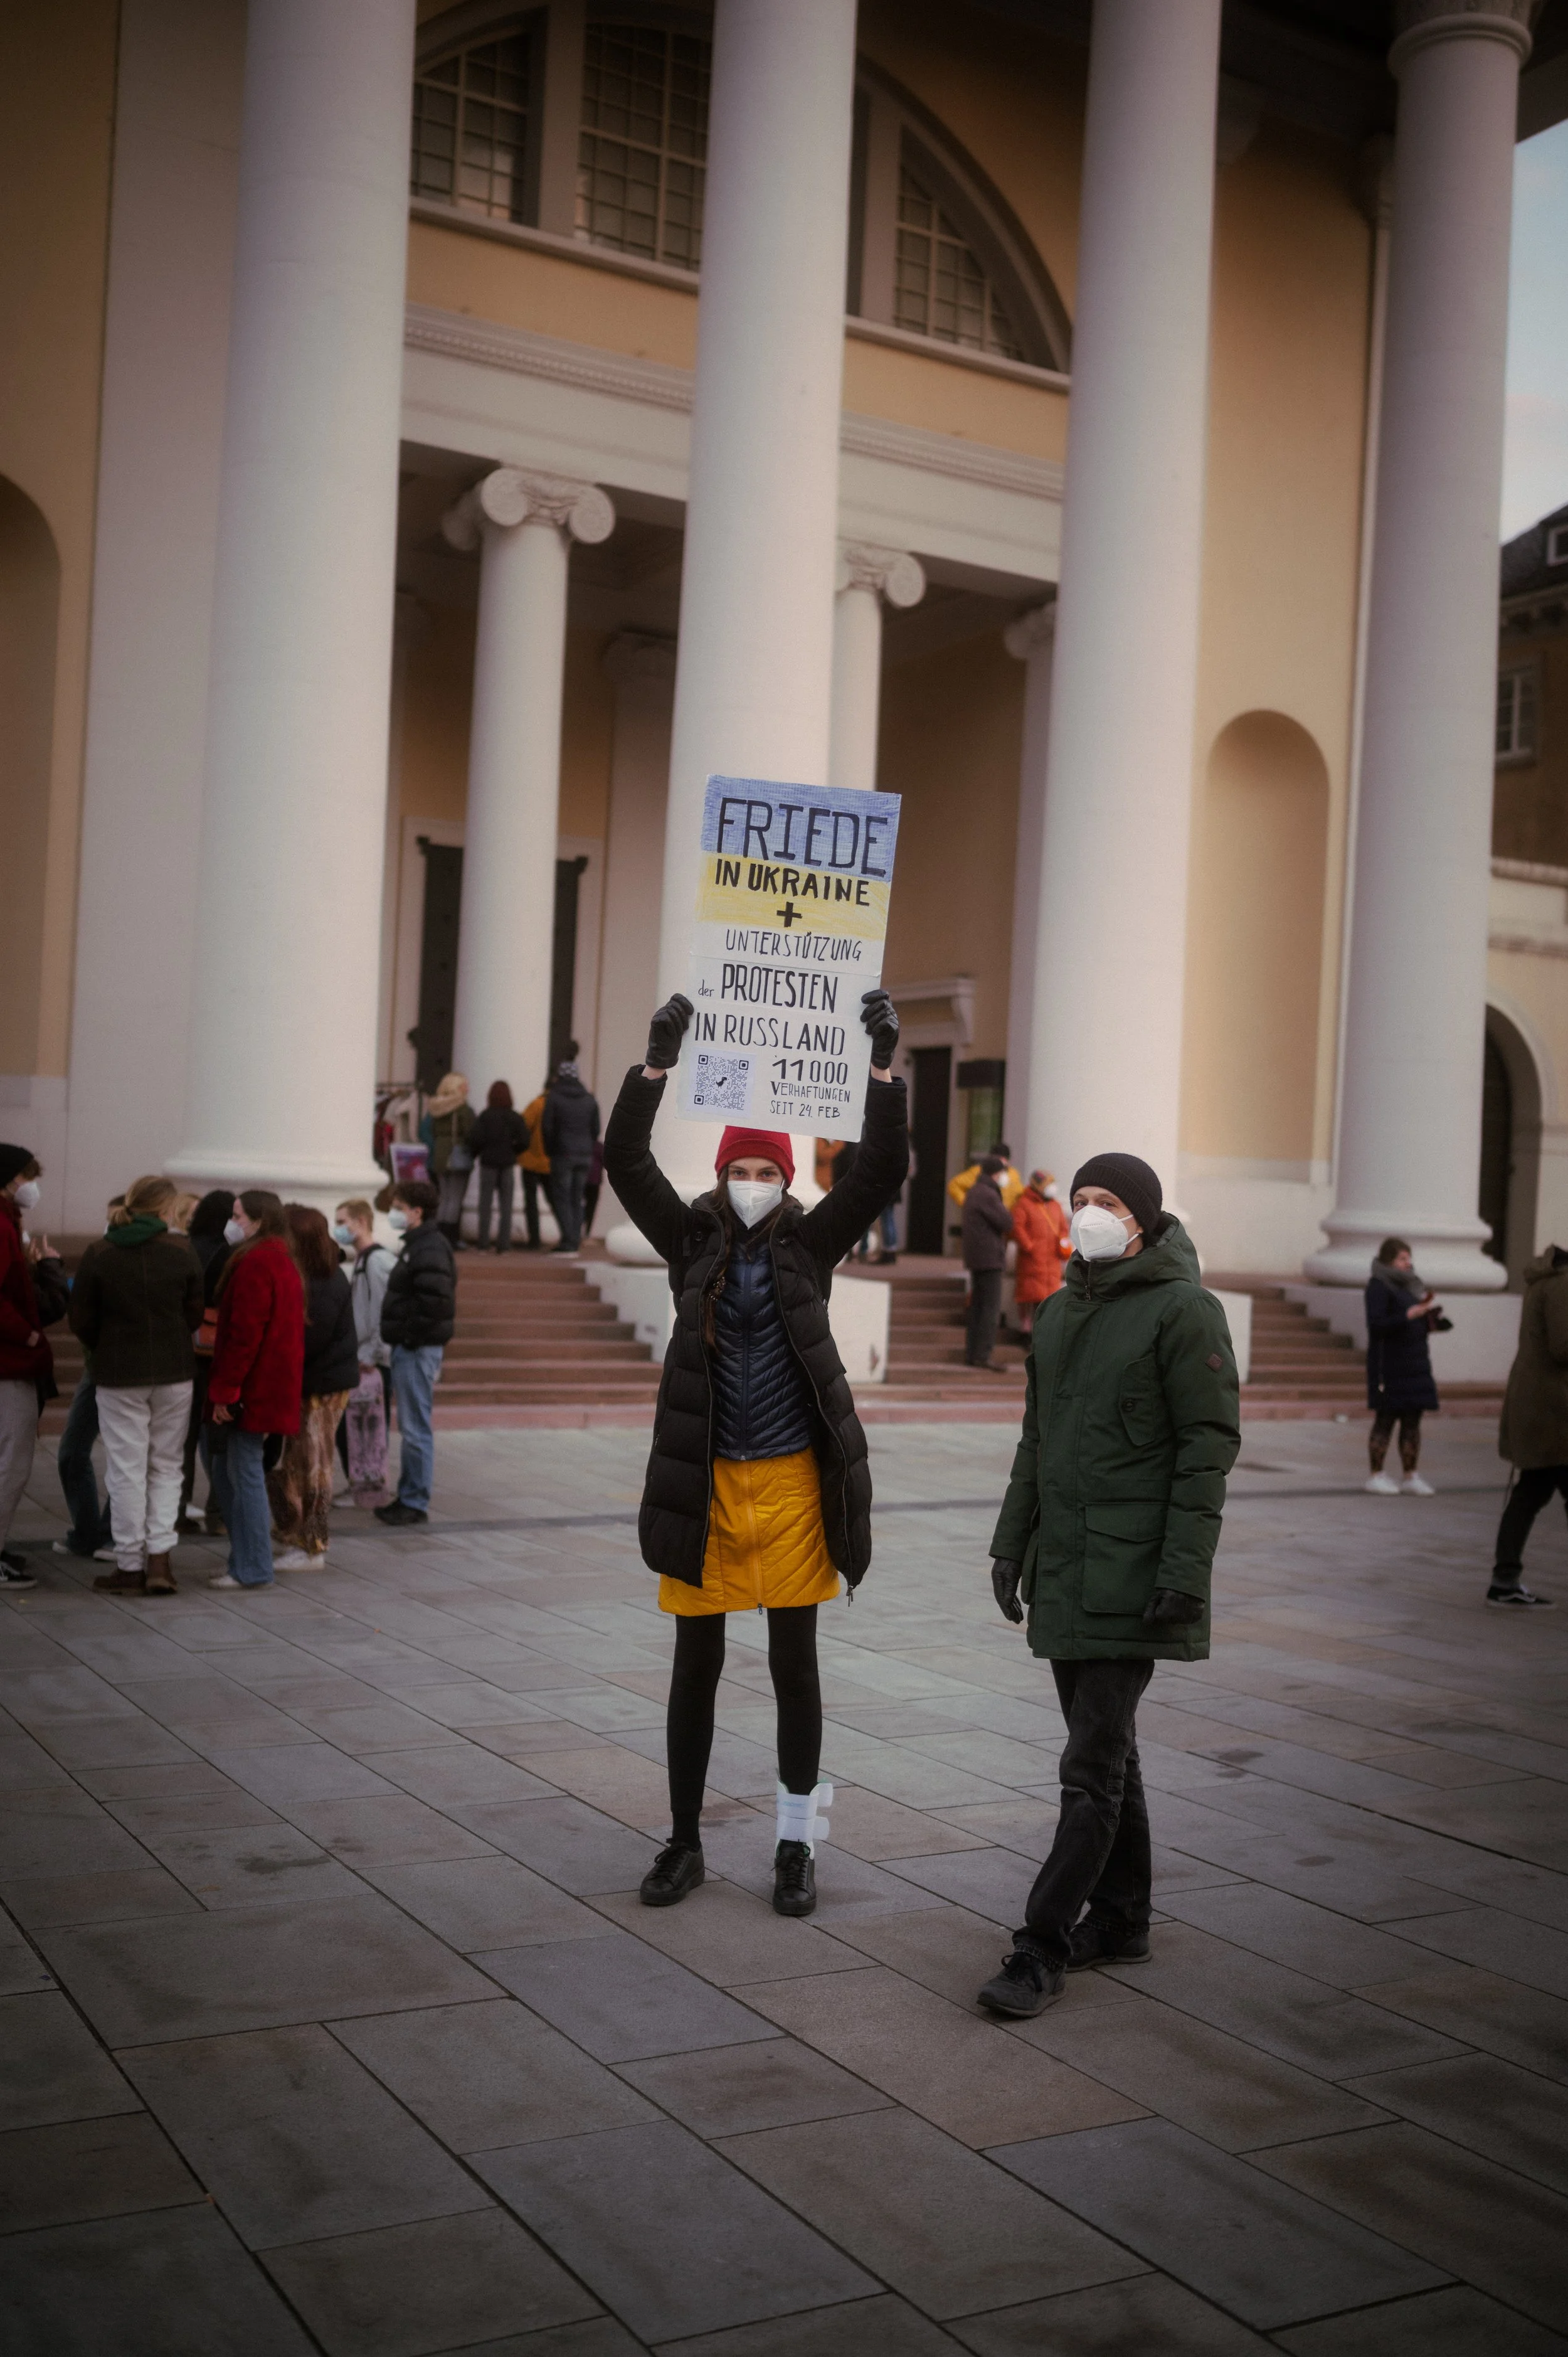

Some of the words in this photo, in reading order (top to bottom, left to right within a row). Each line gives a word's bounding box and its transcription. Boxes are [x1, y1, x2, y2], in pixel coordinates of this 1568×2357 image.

[718, 797, 888, 877] FRIEDE
[715, 859, 741, 887] IN
[748, 863, 870, 907] UKRAINE
[776, 902, 803, 927] +
[726, 928, 862, 961] UNTERSTÜTZUNG
[698, 979, 715, 997] der
[721, 963, 839, 1014] PROTESTEN
[695, 1012, 716, 1041] IN
[724, 1014, 845, 1056] RUSSLAND
[770, 1081, 850, 1103] VERHAFTUNGEN
[770, 1100, 793, 1115] SEIT
[798, 1104, 813, 1118] 24.
[818, 1106, 840, 1118] FEB
